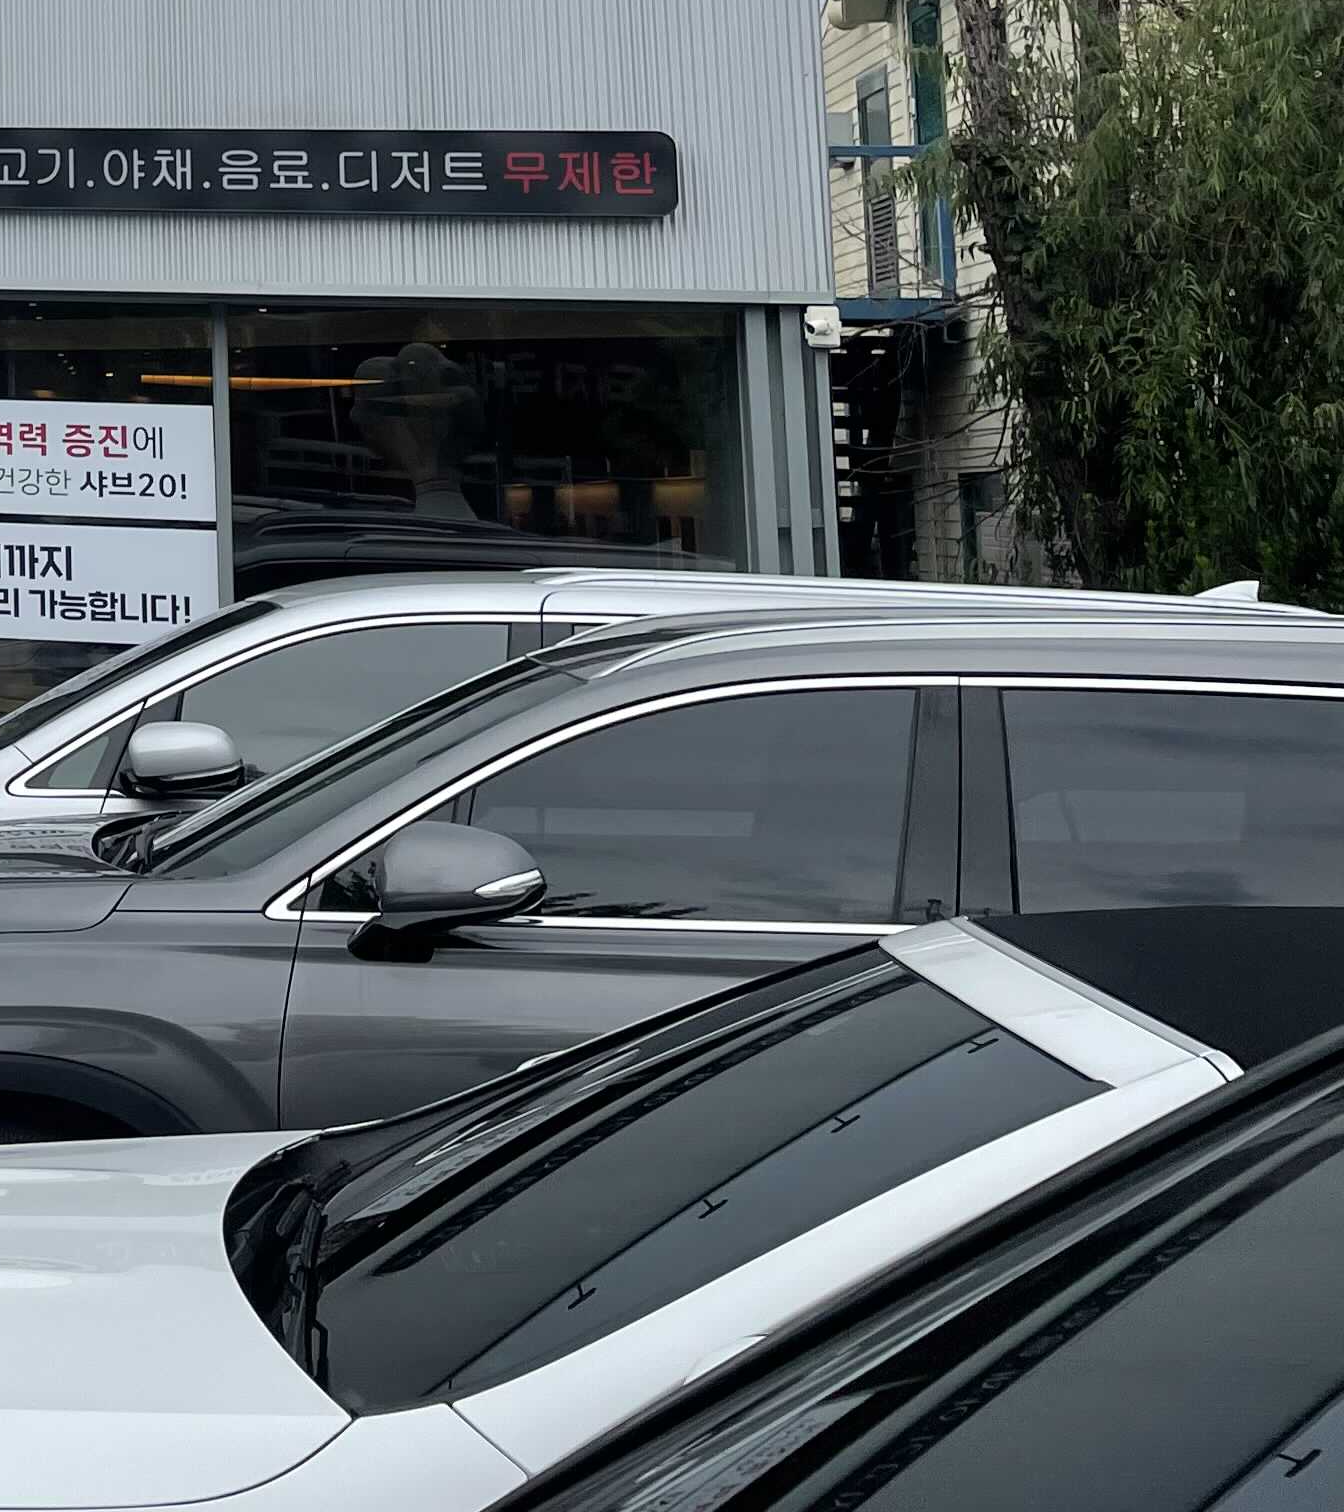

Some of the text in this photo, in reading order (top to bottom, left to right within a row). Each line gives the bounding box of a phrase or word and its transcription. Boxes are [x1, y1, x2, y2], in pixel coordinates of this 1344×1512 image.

[502, 151, 658, 196] 무제한
[62, 424, 164, 460] 증진에
[79, 470, 187, 500] 샤브20!
[28, 589, 191, 625] 가능합니다!
